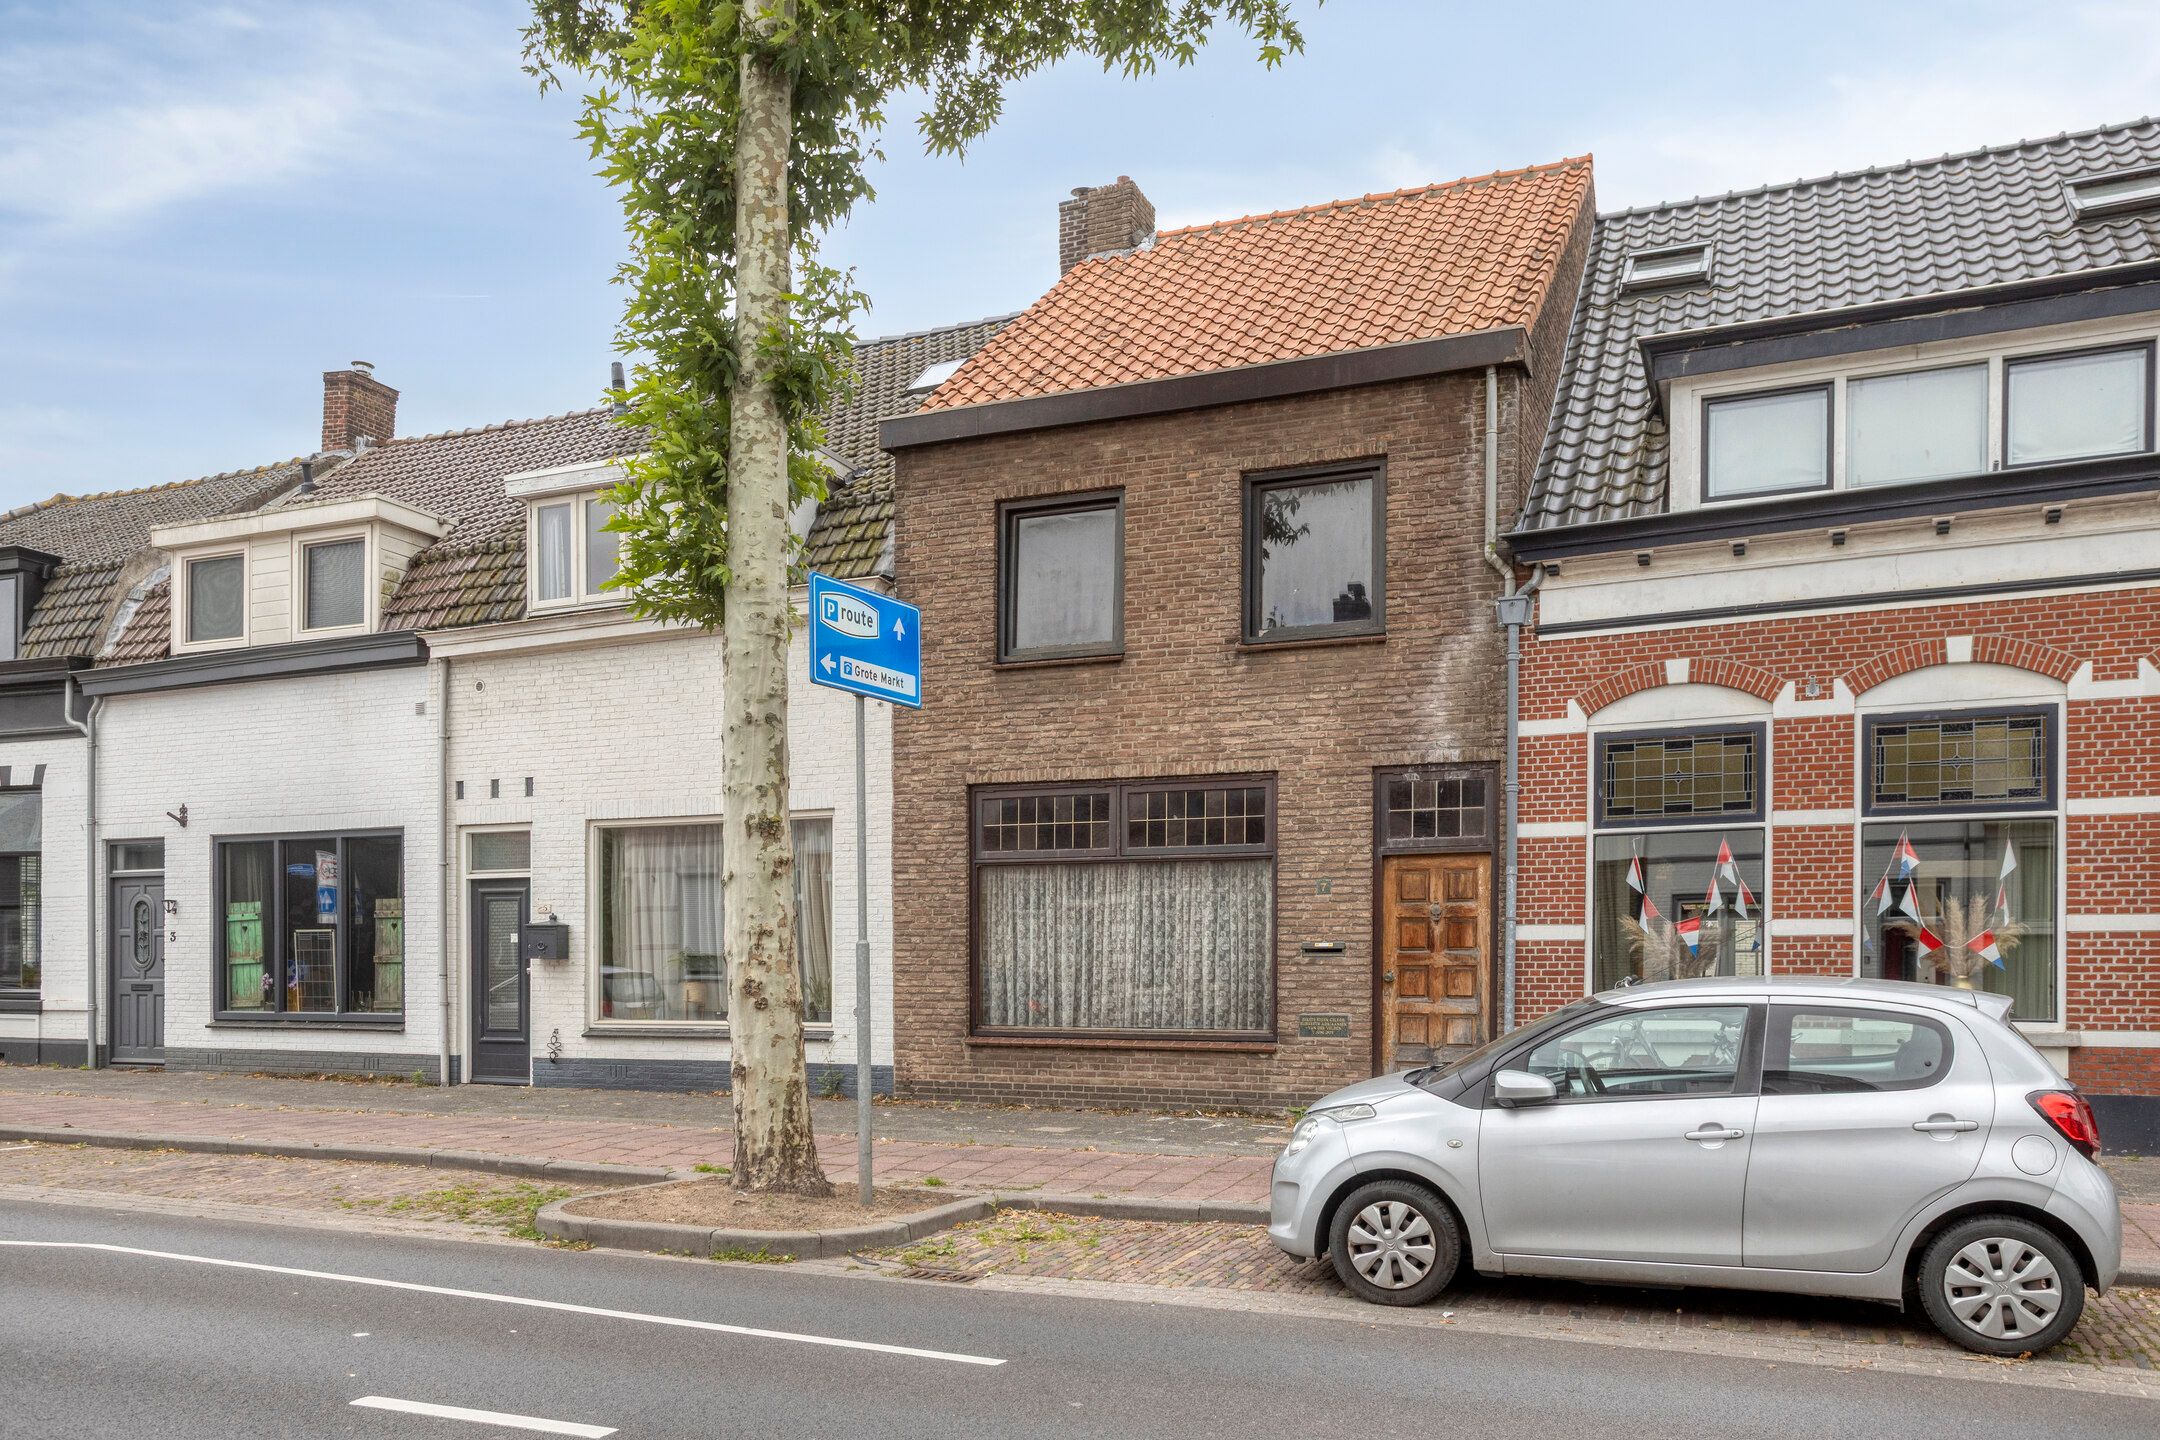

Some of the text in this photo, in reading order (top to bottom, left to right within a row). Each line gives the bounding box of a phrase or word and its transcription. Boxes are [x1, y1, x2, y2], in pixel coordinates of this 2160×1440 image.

[827, 601, 873, 628] P route
[854, 665, 877, 681] Grote
[881, 671, 904, 688] Markt
[1320, 882, 1327, 892] 7
[170, 931, 176, 942] 3
